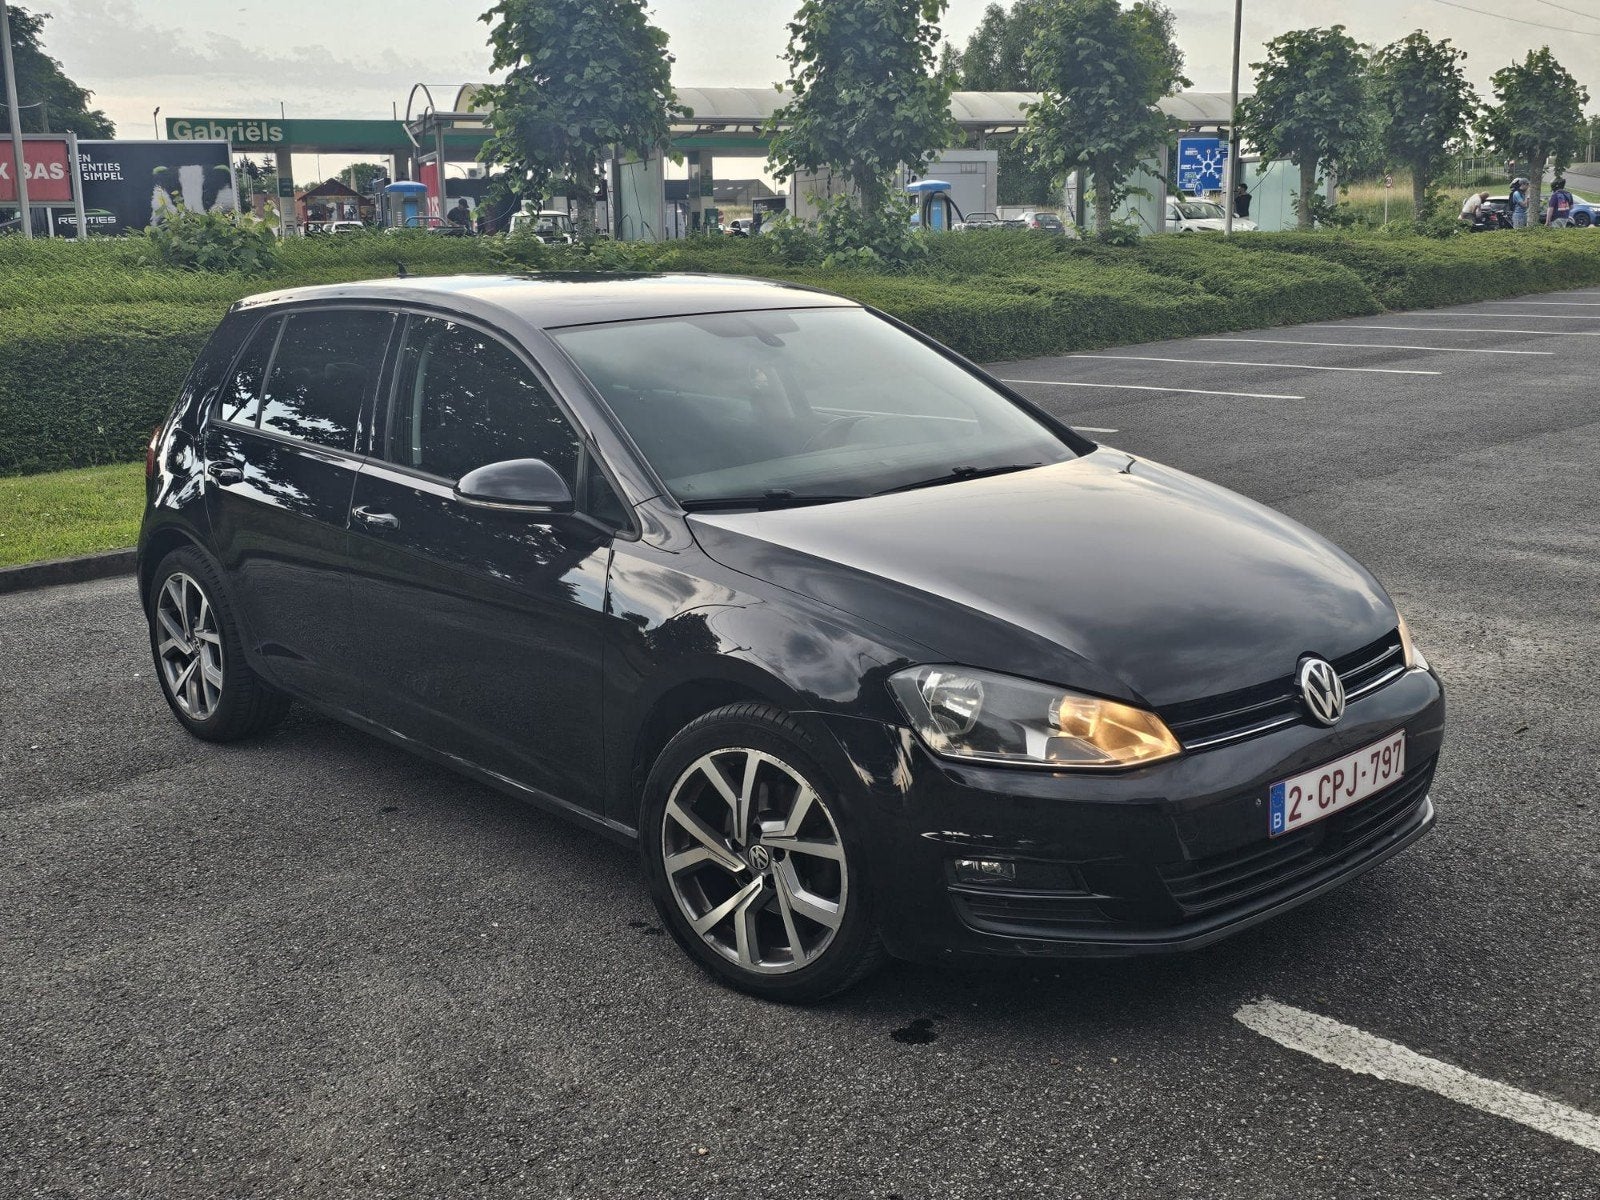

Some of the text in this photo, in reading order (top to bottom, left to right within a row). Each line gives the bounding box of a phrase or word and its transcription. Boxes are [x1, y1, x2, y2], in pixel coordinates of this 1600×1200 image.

[172, 120, 283, 142] Gabriëls
[23, 162, 65, 180] BAS
[78, 162, 121, 172] ENTIES
[83, 172, 124, 181] SIMPEL
[58, 216, 117, 225] RETIES
[1288, 739, 1402, 823] 2-CPJ-797
[1273, 811, 1282, 830] B
